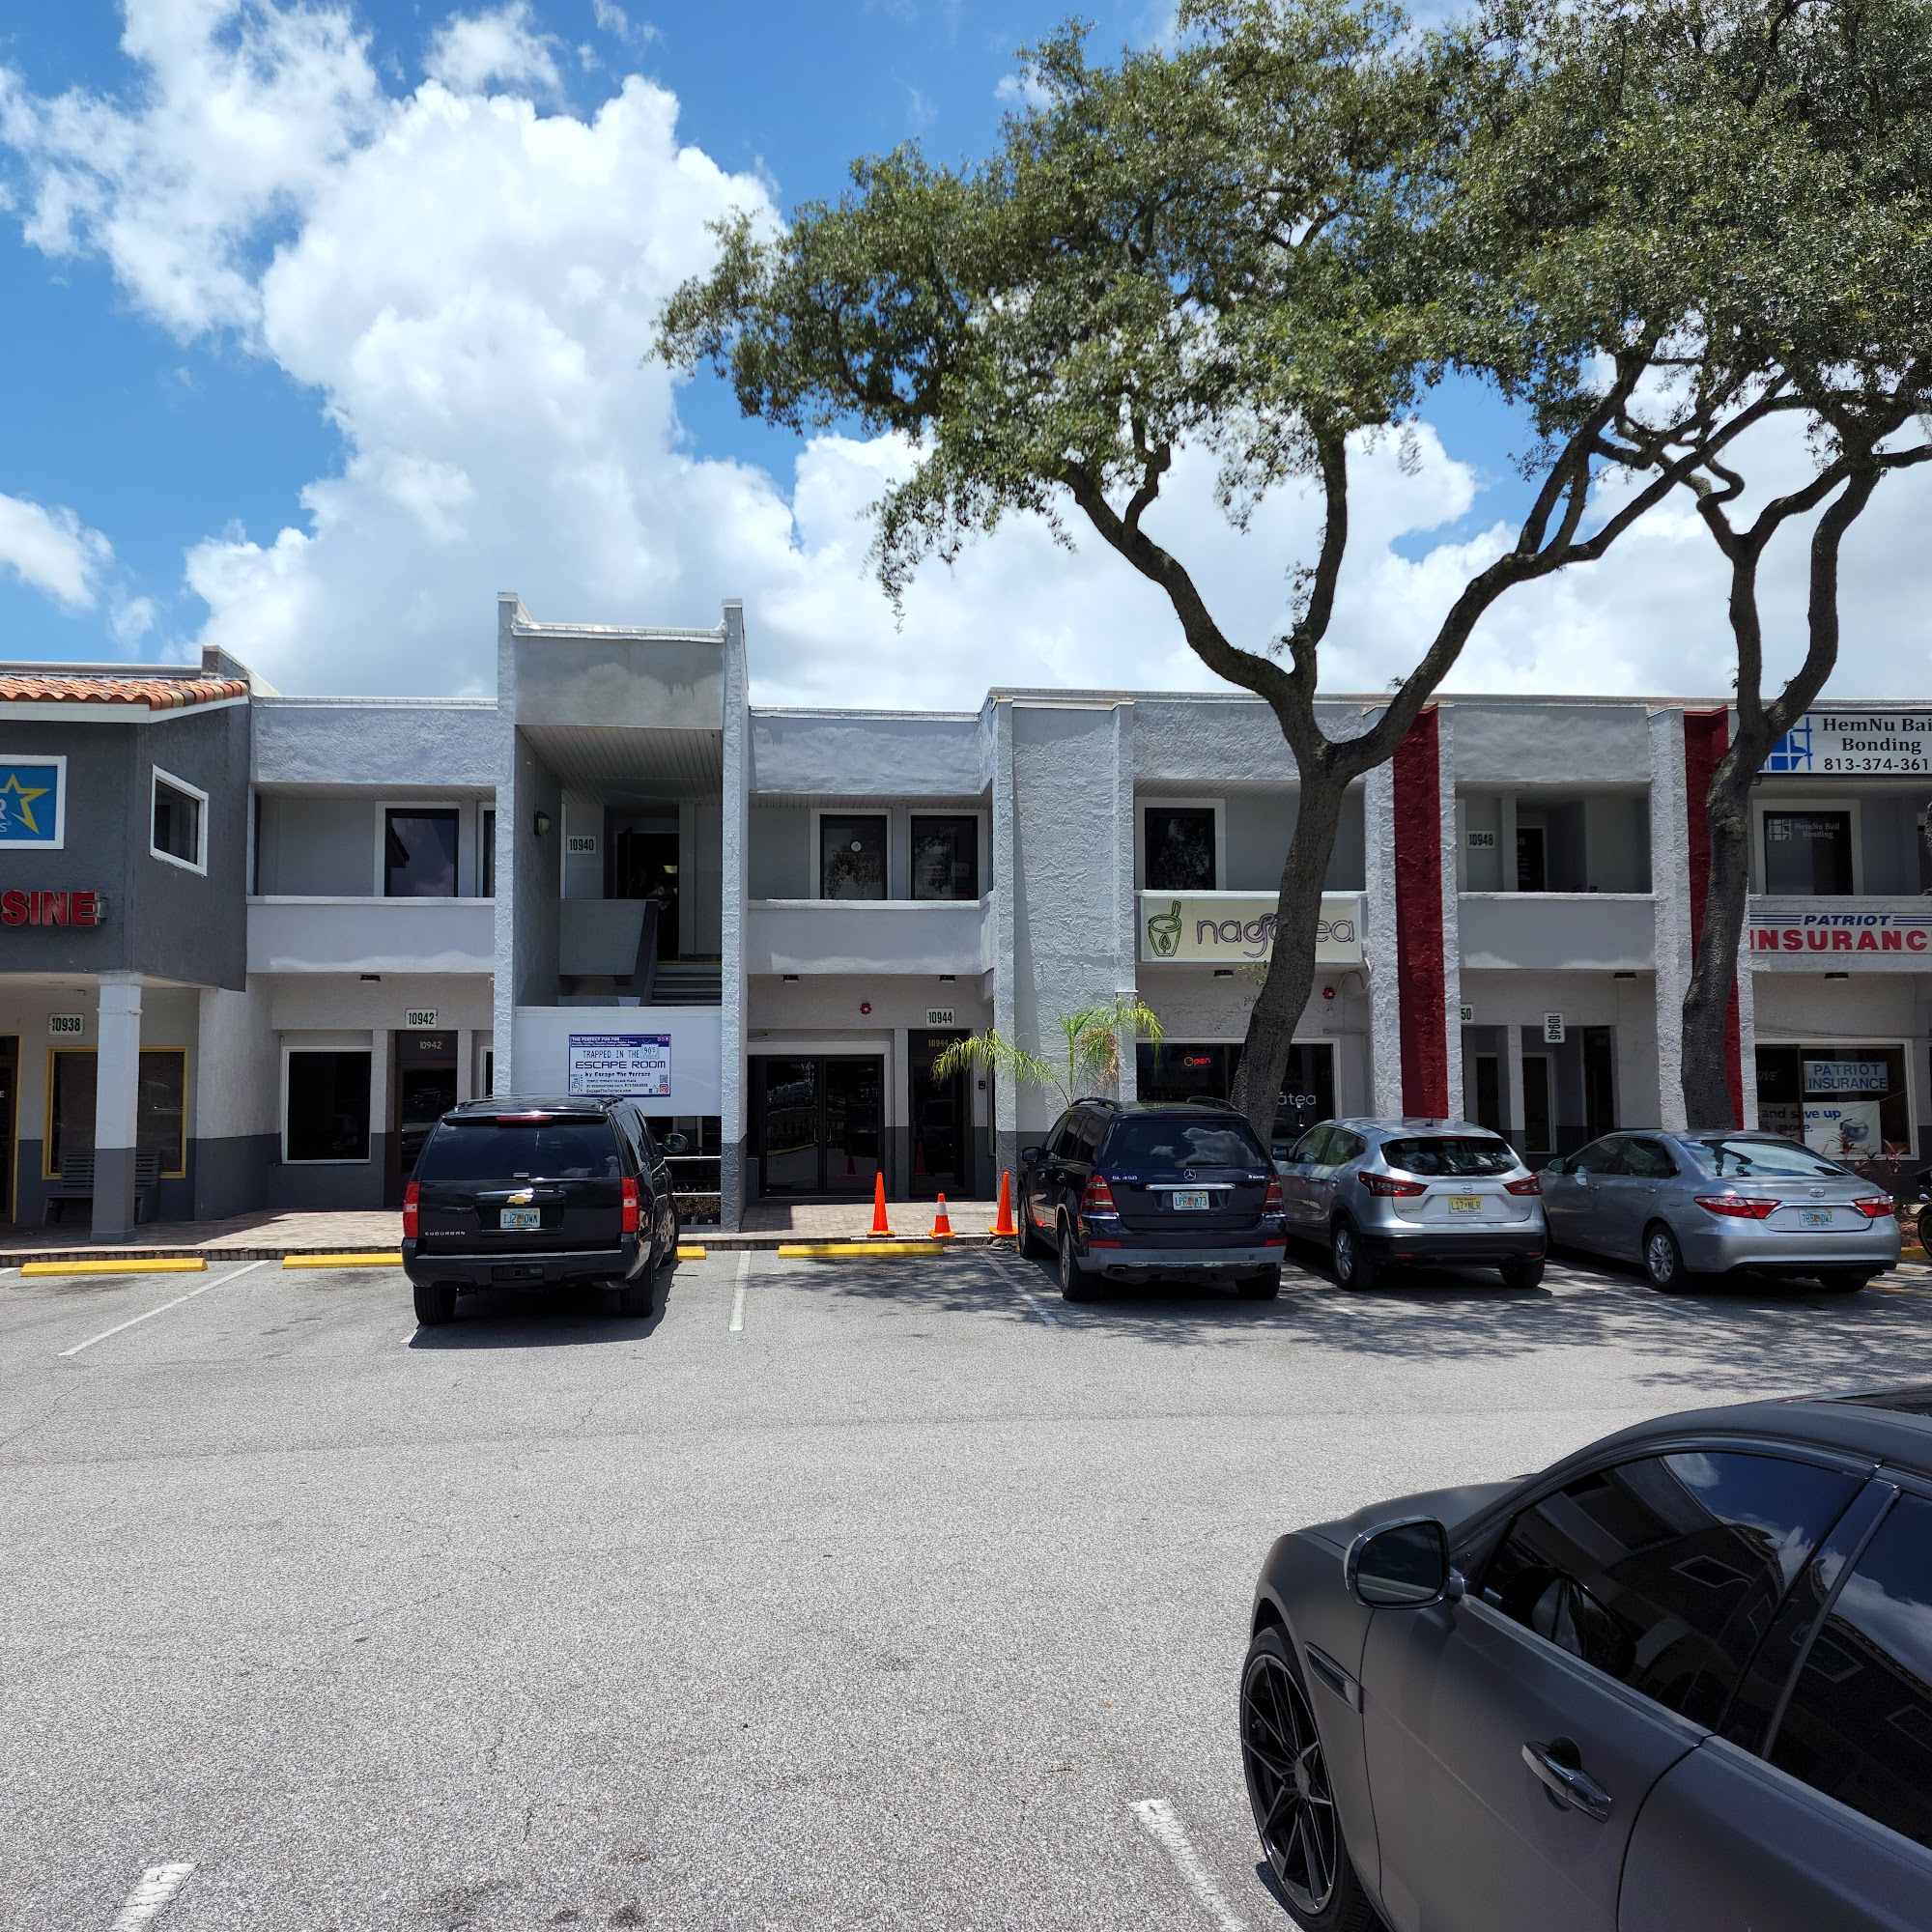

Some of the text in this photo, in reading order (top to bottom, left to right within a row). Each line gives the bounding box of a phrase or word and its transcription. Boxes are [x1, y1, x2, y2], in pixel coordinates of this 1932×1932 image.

[1822, 718, 1932, 732] HemNu Bai
[1841, 737, 1922, 755] Bonding
[1824, 757, 1929, 771] 813-374-361
[1468, 833, 1494, 846] 10948
[1803, 830, 1834, 838] Bonding
[569, 838, 594, 851] 10940
[0, 889, 98, 926] SINE
[1804, 915, 1891, 926] PATRIOT
[1749, 929, 1932, 952] INSURANC
[408, 1011, 435, 1025] 10942
[928, 1011, 952, 1024] 10944
[1460, 1008, 1472, 1021] 50
[51, 1017, 81, 1032] 10938
[1548, 1014, 1562, 1040] 10946
[419, 1040, 442, 1050] 10942
[927, 1038, 949, 1047] 10944
[582, 1050, 611, 1059] TRAPPED
[615, 1050, 624, 1059] IN
[628, 1050, 639, 1059] THE
[1183, 1056, 1211, 1067] Open
[1813, 1064, 1881, 1076] PATRIOT
[1808, 1077, 1888, 1090] INSURANCE
[1761, 1107, 1842, 1121] and sve up
